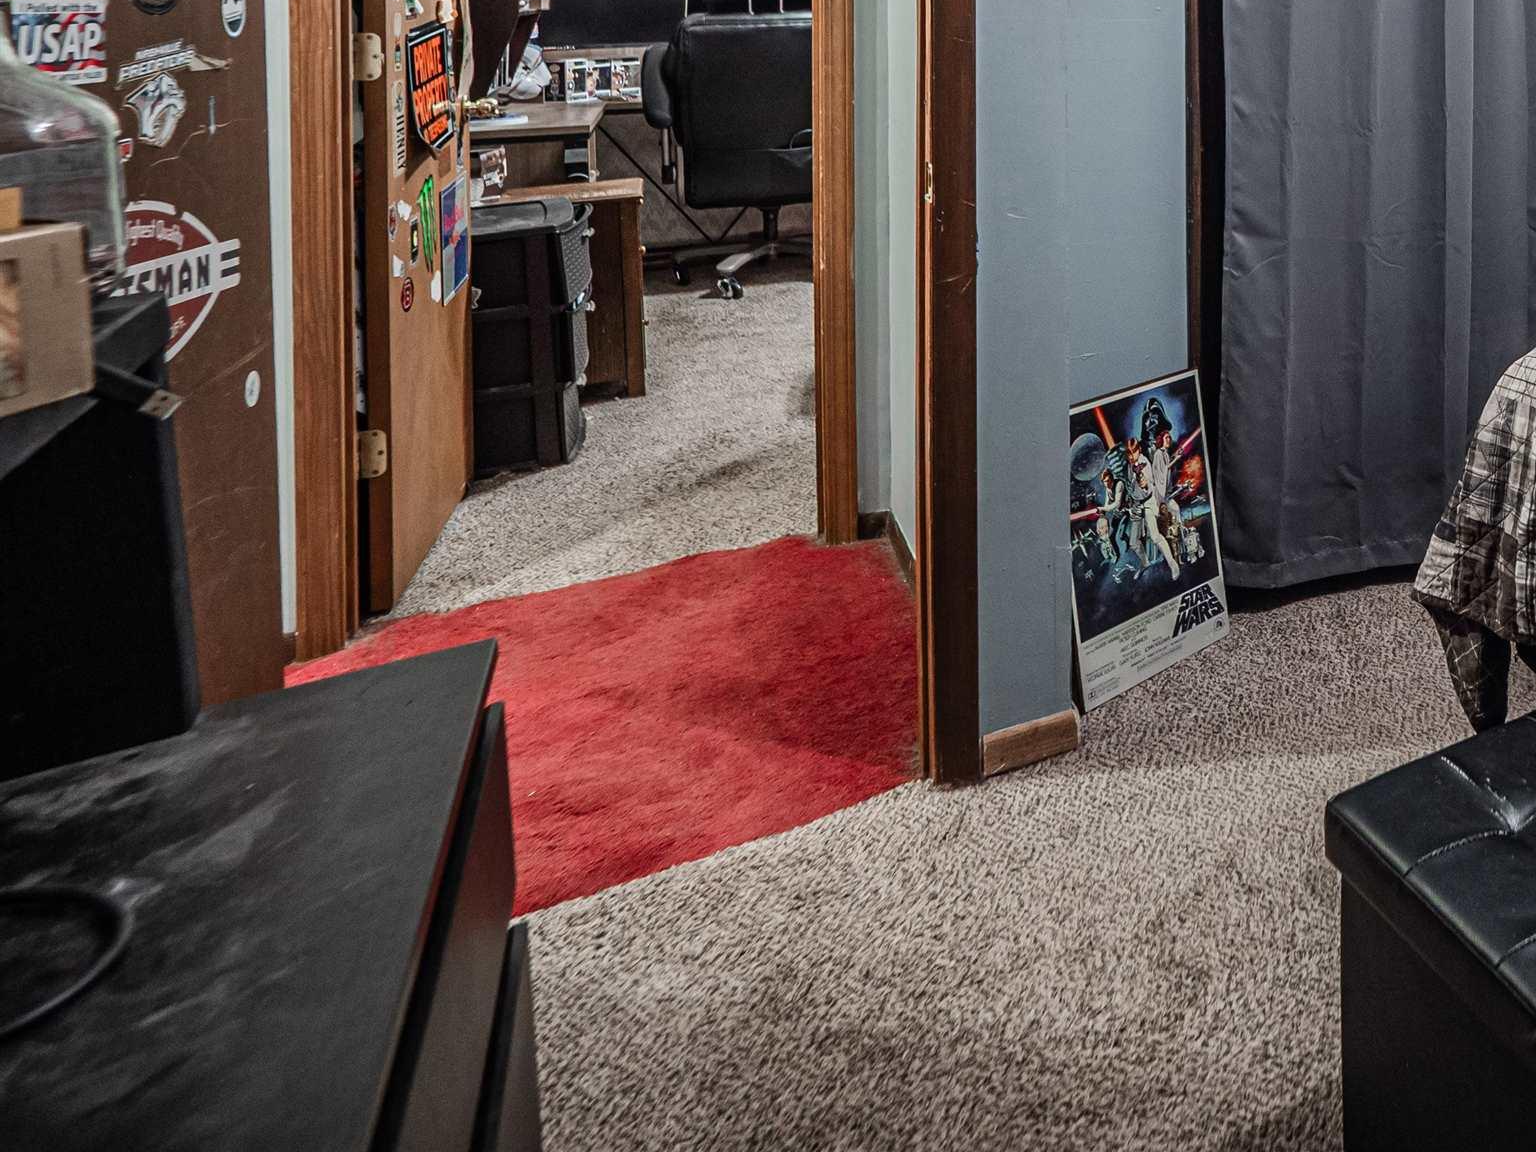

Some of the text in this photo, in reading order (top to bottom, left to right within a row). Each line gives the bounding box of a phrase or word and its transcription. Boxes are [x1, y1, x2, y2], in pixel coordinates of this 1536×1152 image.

[18, 21, 102, 65] USAP
[413, 35, 443, 87] PRIVATE
[412, 74, 449, 128] PROPERTY
[1172, 597, 1225, 637] WARS
[1179, 583, 1216, 612] STAR
